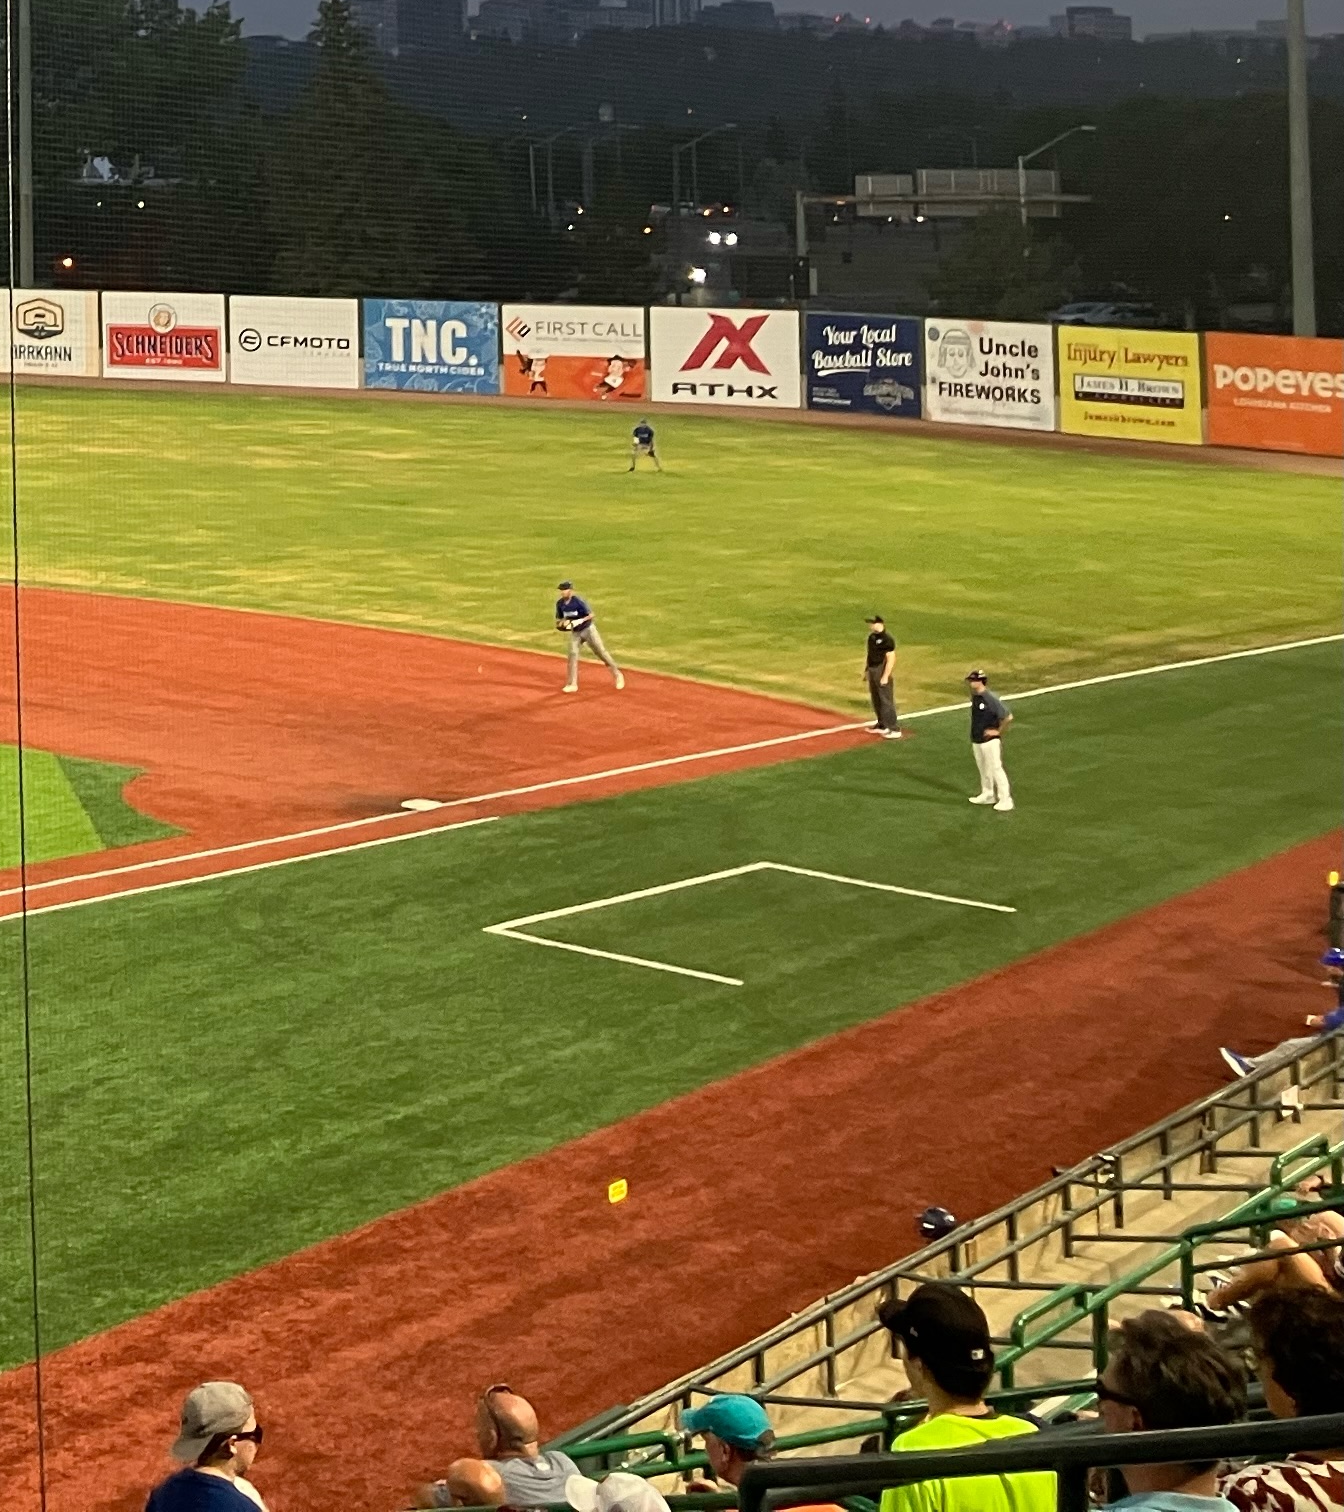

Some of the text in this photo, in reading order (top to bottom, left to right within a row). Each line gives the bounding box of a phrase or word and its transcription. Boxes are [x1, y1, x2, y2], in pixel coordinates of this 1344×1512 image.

[535, 321, 643, 338] FIRST CALL
[823, 323, 897, 348] Your Local
[112, 332, 214, 362] SCHNEIDERS
[267, 336, 350, 350] CFMOTO
[979, 337, 1039, 358] Uncle
[812, 348, 913, 369] Baseball Store
[1067, 343, 1188, 371] Injury Lawyers
[378, 363, 485, 376] TRUE NORTH CIDER
[979, 360, 1040, 381] John's
[672, 382, 779, 400] ATHX
[939, 381, 1041, 405] FIREWORKS
